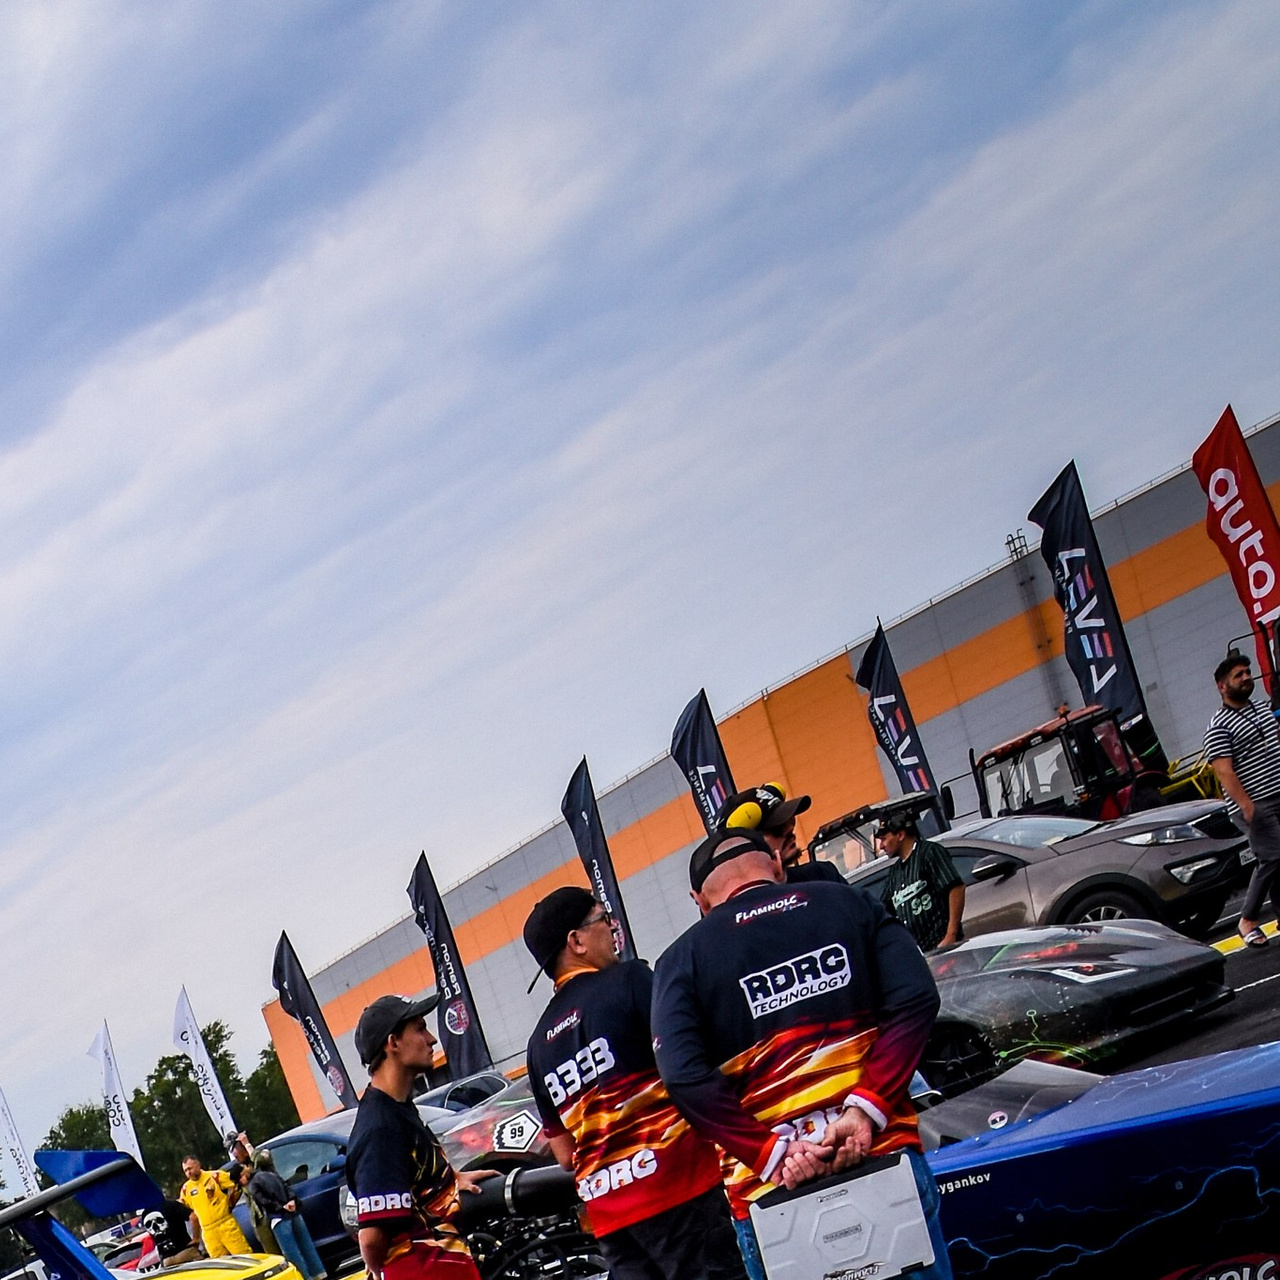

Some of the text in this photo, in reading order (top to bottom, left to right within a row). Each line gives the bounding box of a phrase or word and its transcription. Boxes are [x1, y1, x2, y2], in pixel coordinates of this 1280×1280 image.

[1208, 468, 1280, 623] auto.
[735, 895, 797, 923] FLAMHOLC
[743, 946, 846, 1003] RDRC
[754, 974, 848, 1015] TECHNOLOGY
[509, 1126, 524, 1140] 99
[936, 1173, 991, 1195] ygankov
[358, 1192, 412, 1214] RDRC
